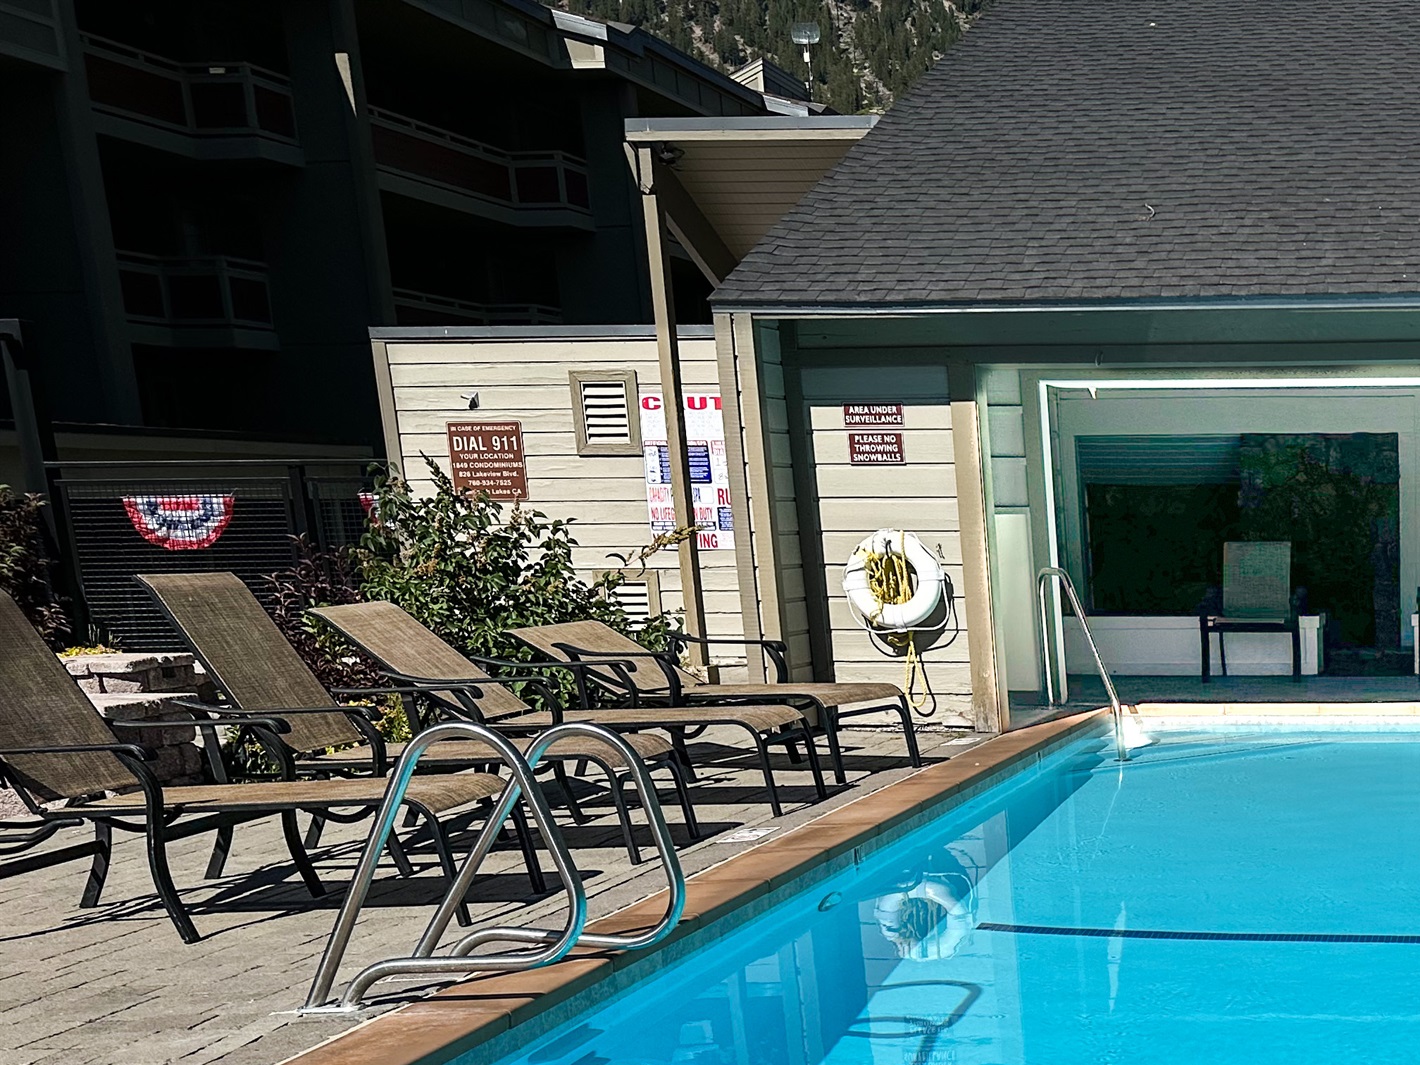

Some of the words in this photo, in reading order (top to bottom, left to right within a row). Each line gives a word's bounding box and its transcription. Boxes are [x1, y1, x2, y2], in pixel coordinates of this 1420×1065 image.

[642, 396, 722, 410] CUT
[849, 405, 869, 414] AREA
[870, 405, 898, 414] UNDER
[845, 415, 902, 423] SURVEILLANCE
[452, 436, 487, 451] DIAL
[492, 435, 518, 451] 911
[854, 434, 882, 443] PLEASE
[883, 434, 896, 443] NO
[854, 444, 898, 452] THROWING
[853, 453, 901, 461] SNOWBALLS
